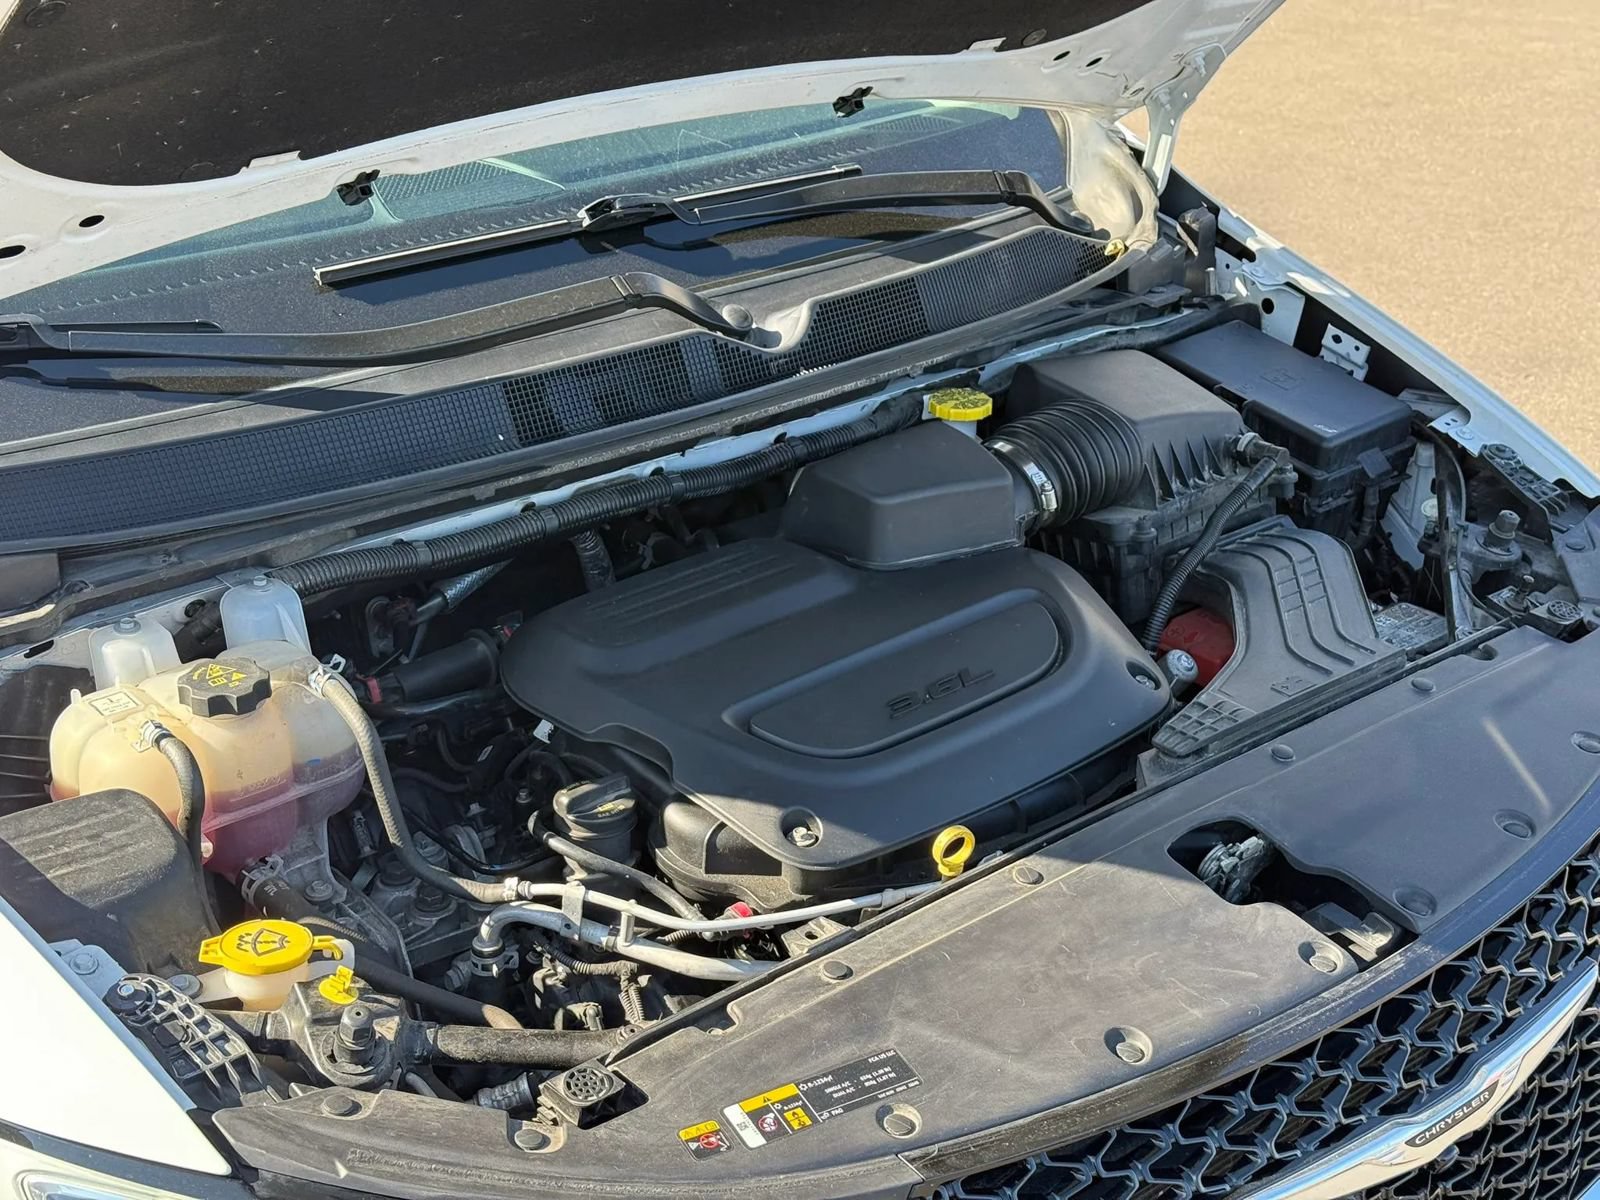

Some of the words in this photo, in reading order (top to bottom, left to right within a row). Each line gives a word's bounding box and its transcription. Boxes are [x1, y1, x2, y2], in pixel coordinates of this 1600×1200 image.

[886, 667, 996, 719] 3.6L
[867, 1055, 880, 1063] FCA
[807, 1074, 833, 1089] R-1234yf
[1415, 1090, 1490, 1145] CHRYSLER
